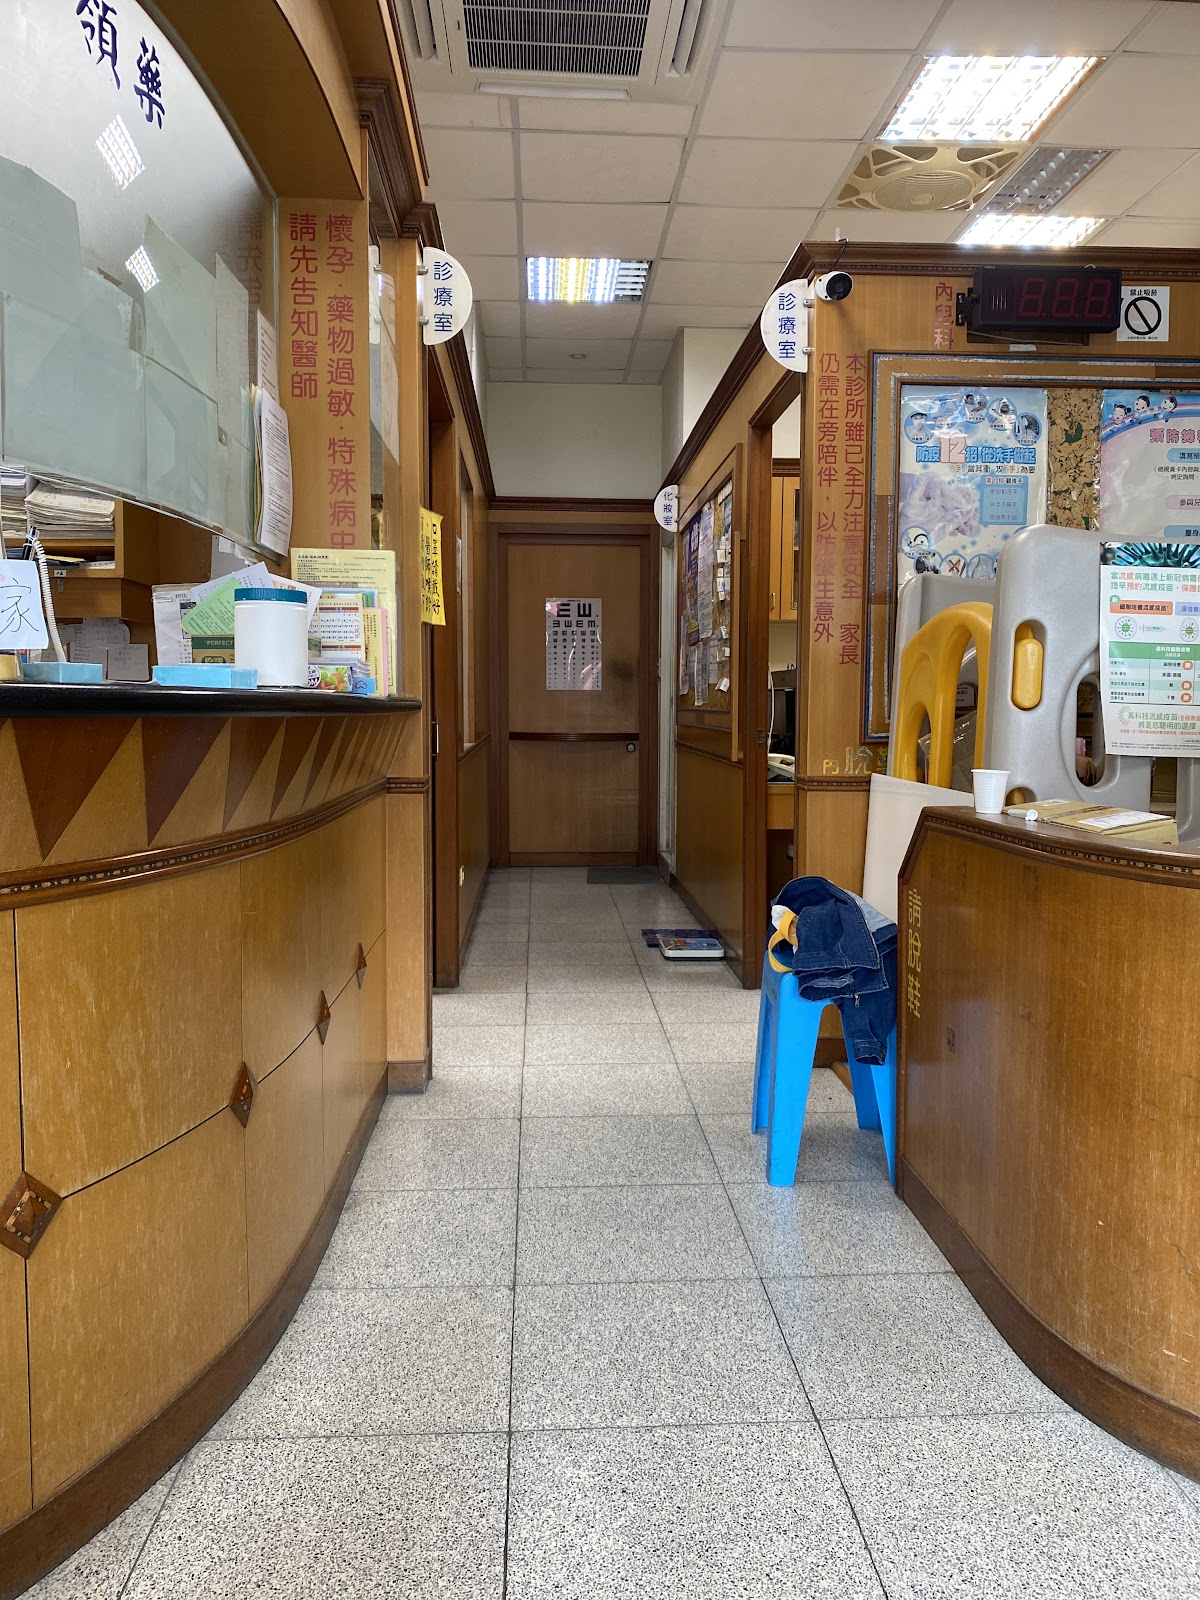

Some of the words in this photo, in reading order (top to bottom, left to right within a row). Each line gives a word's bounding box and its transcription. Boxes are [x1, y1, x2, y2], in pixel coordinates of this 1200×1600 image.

[290, 213, 318, 399] 請先告知醫師
[433, 261, 453, 332] 診療室
[778, 292, 796, 359] 診療室
[934, 282, 954, 350] 內兒科
[1149, 428, 1200, 443] 預防接
[663, 491, 673, 525] 化妝室
[841, 352, 866, 600] 本診所雖已全力注意安全
[1110, 572, 1200, 583] 當流感病毒遇上新冠病毒
[839, 623, 860, 665] 家長
